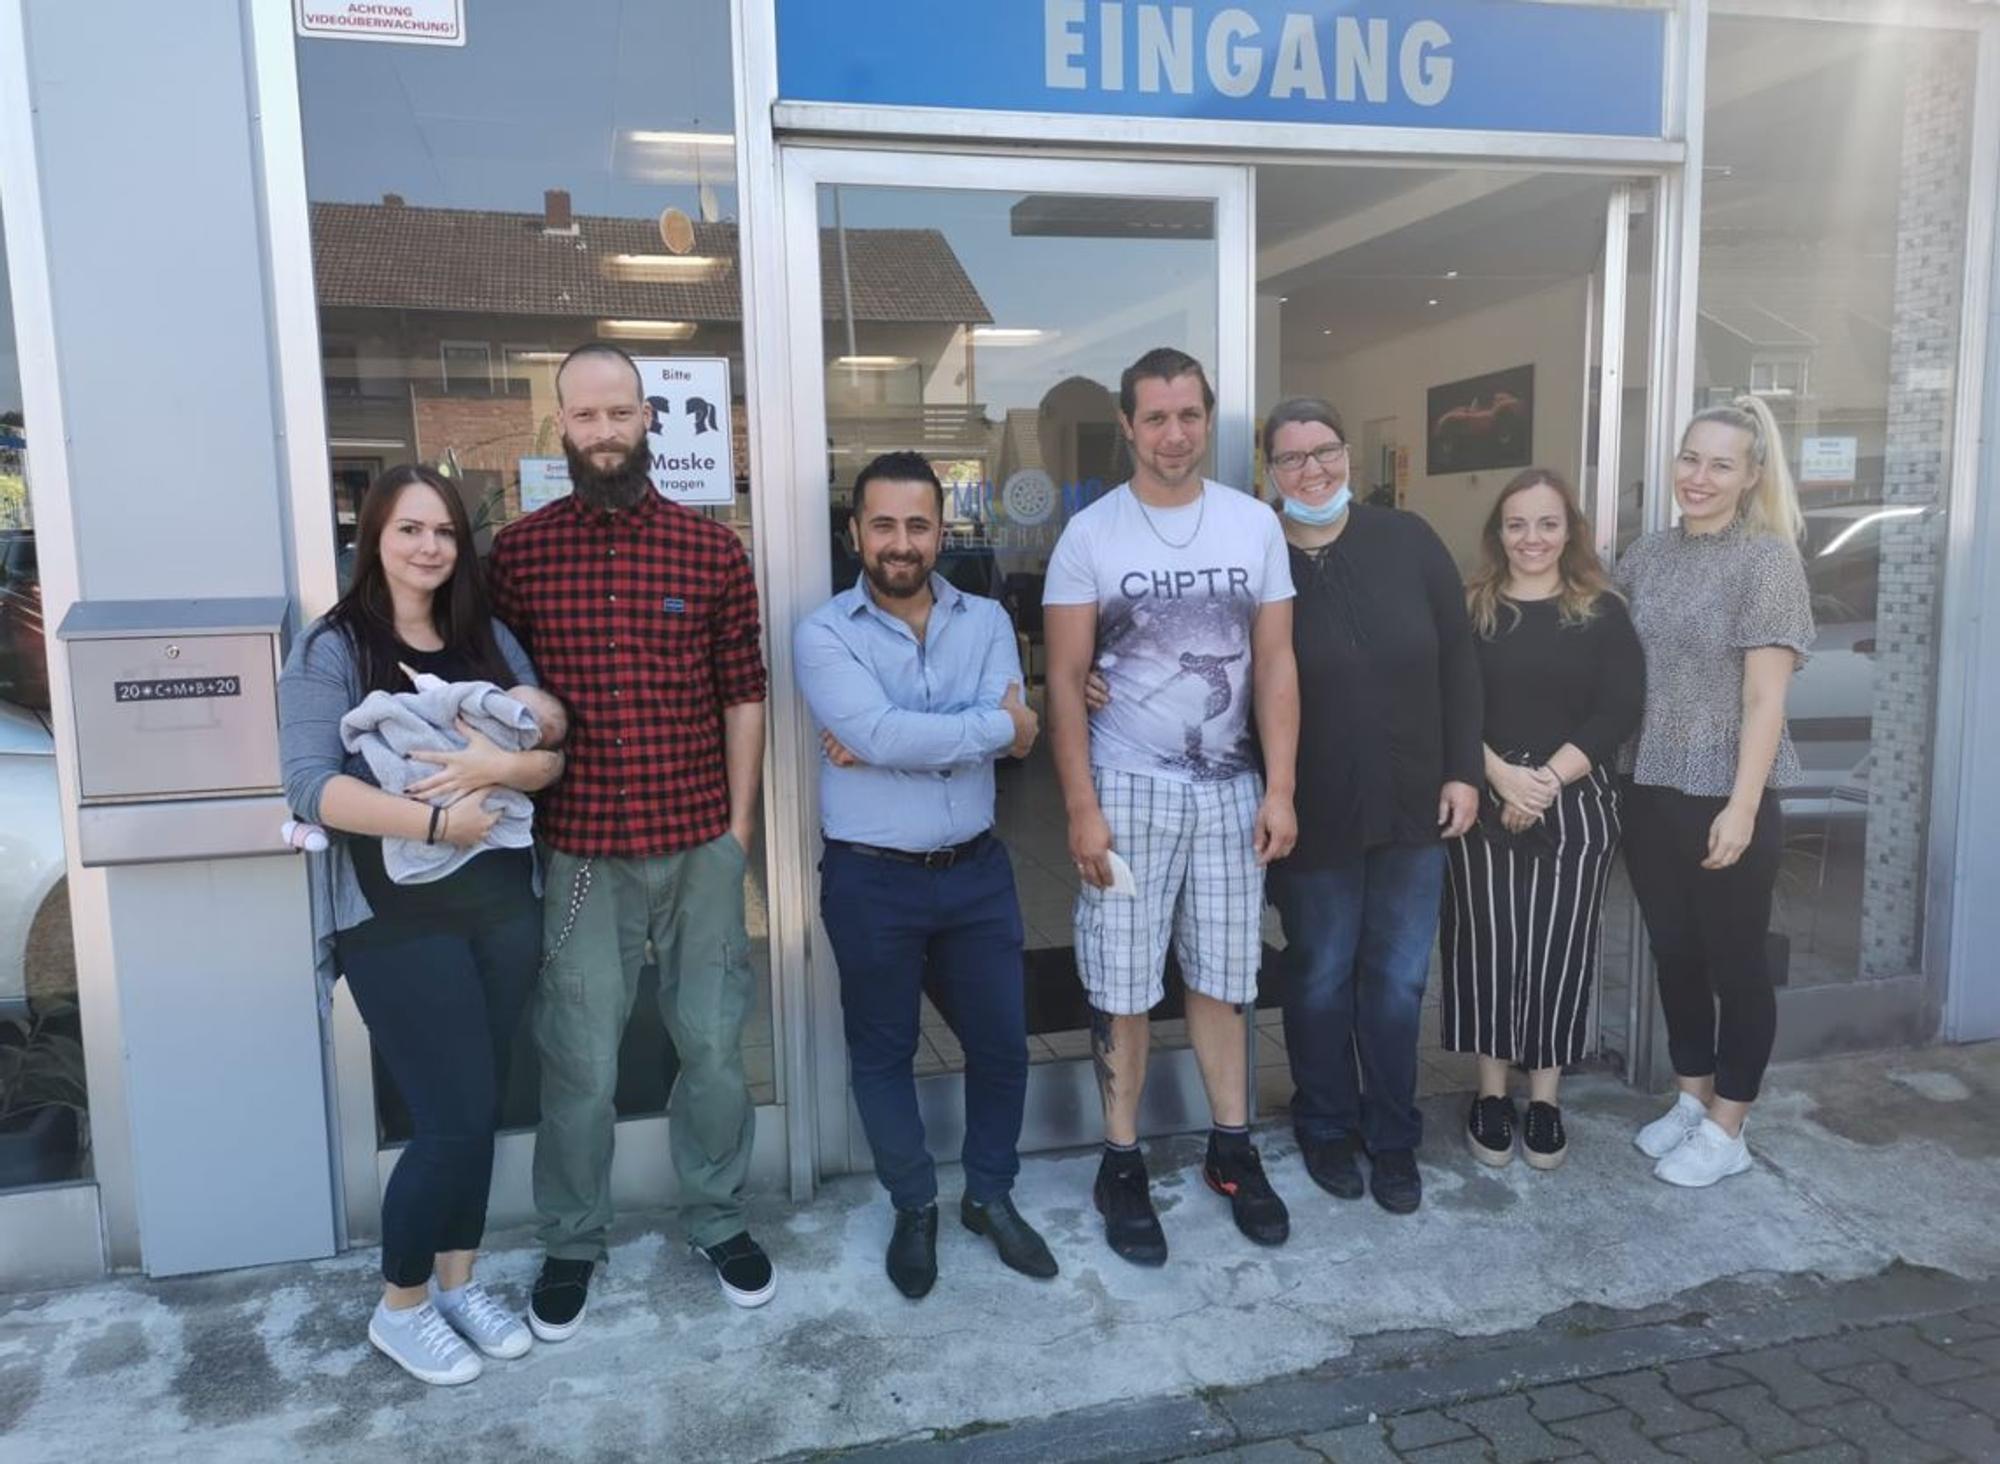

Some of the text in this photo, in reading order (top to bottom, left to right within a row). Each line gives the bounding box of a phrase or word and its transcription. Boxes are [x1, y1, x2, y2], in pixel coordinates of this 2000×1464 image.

[348, 3, 413, 17] ACHTUNG
[1045, 0, 1453, 106] EINGANG
[662, 369, 691, 380] Bitte
[652, 452, 715, 470] Maske
[660, 478, 704, 490] tragen
[1120, 567, 1254, 600] CHPTR
